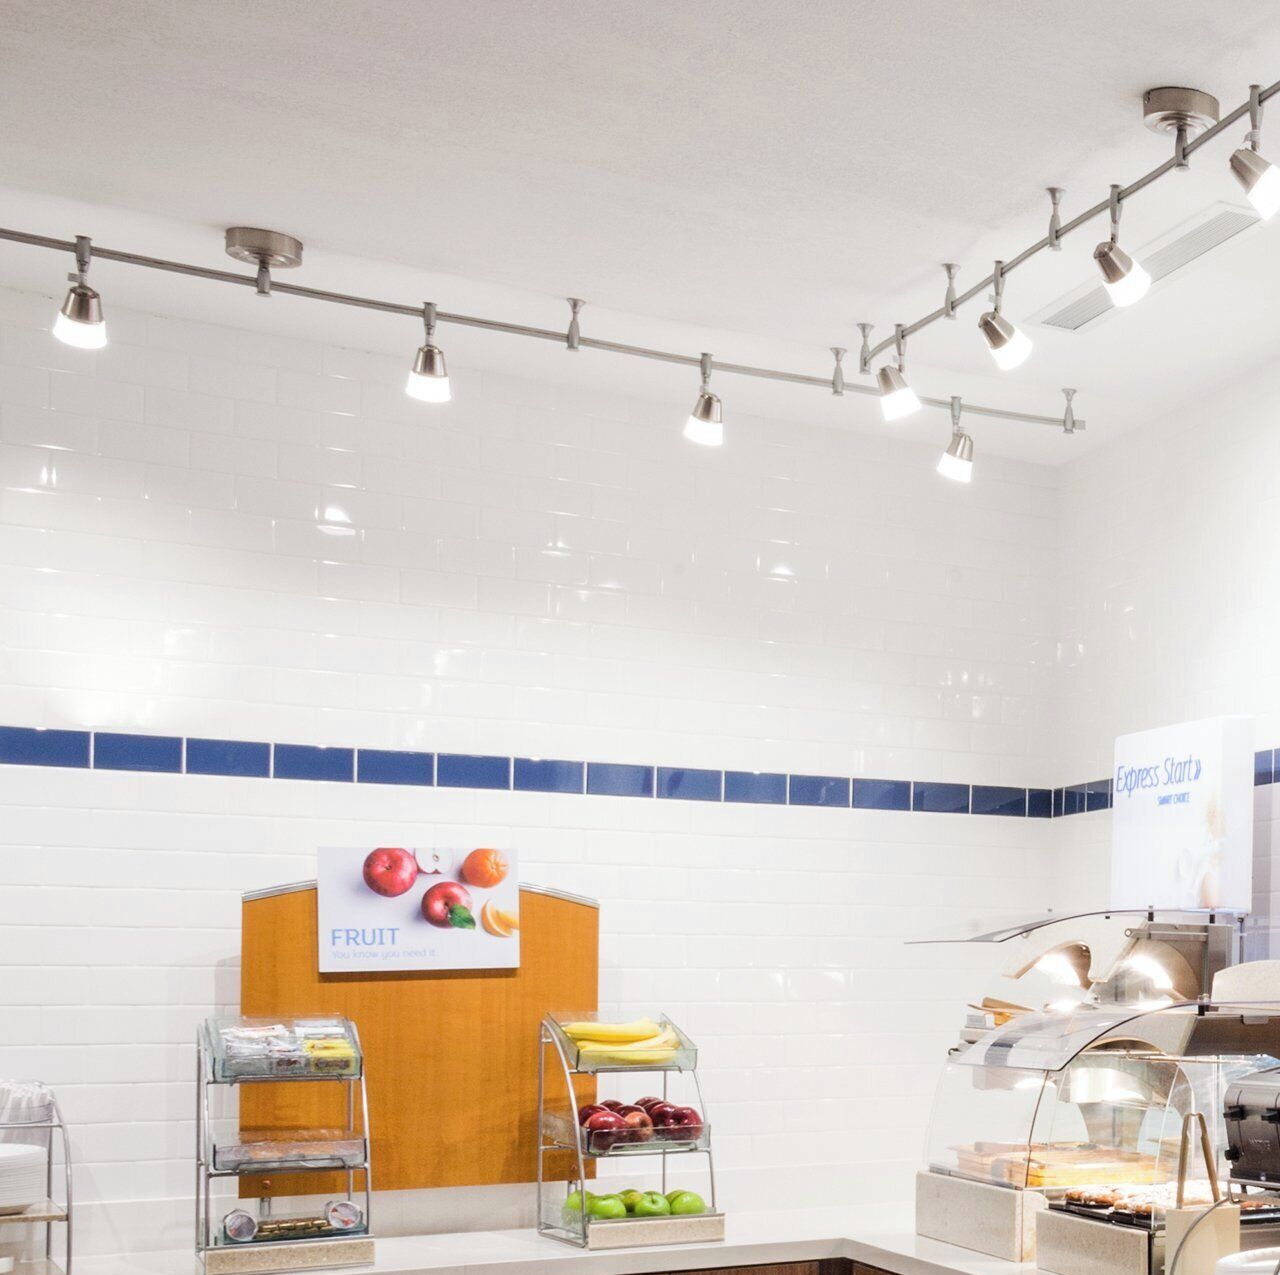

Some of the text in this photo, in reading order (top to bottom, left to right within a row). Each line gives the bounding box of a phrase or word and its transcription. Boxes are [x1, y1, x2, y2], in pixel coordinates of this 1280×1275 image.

[1115, 754, 1193, 798] Express Start
[331, 927, 400, 946] FRUIT
[331, 950, 350, 959] You
[352, 949, 379, 958] know
[381, 950, 400, 961] you
[402, 948, 428, 958] need
